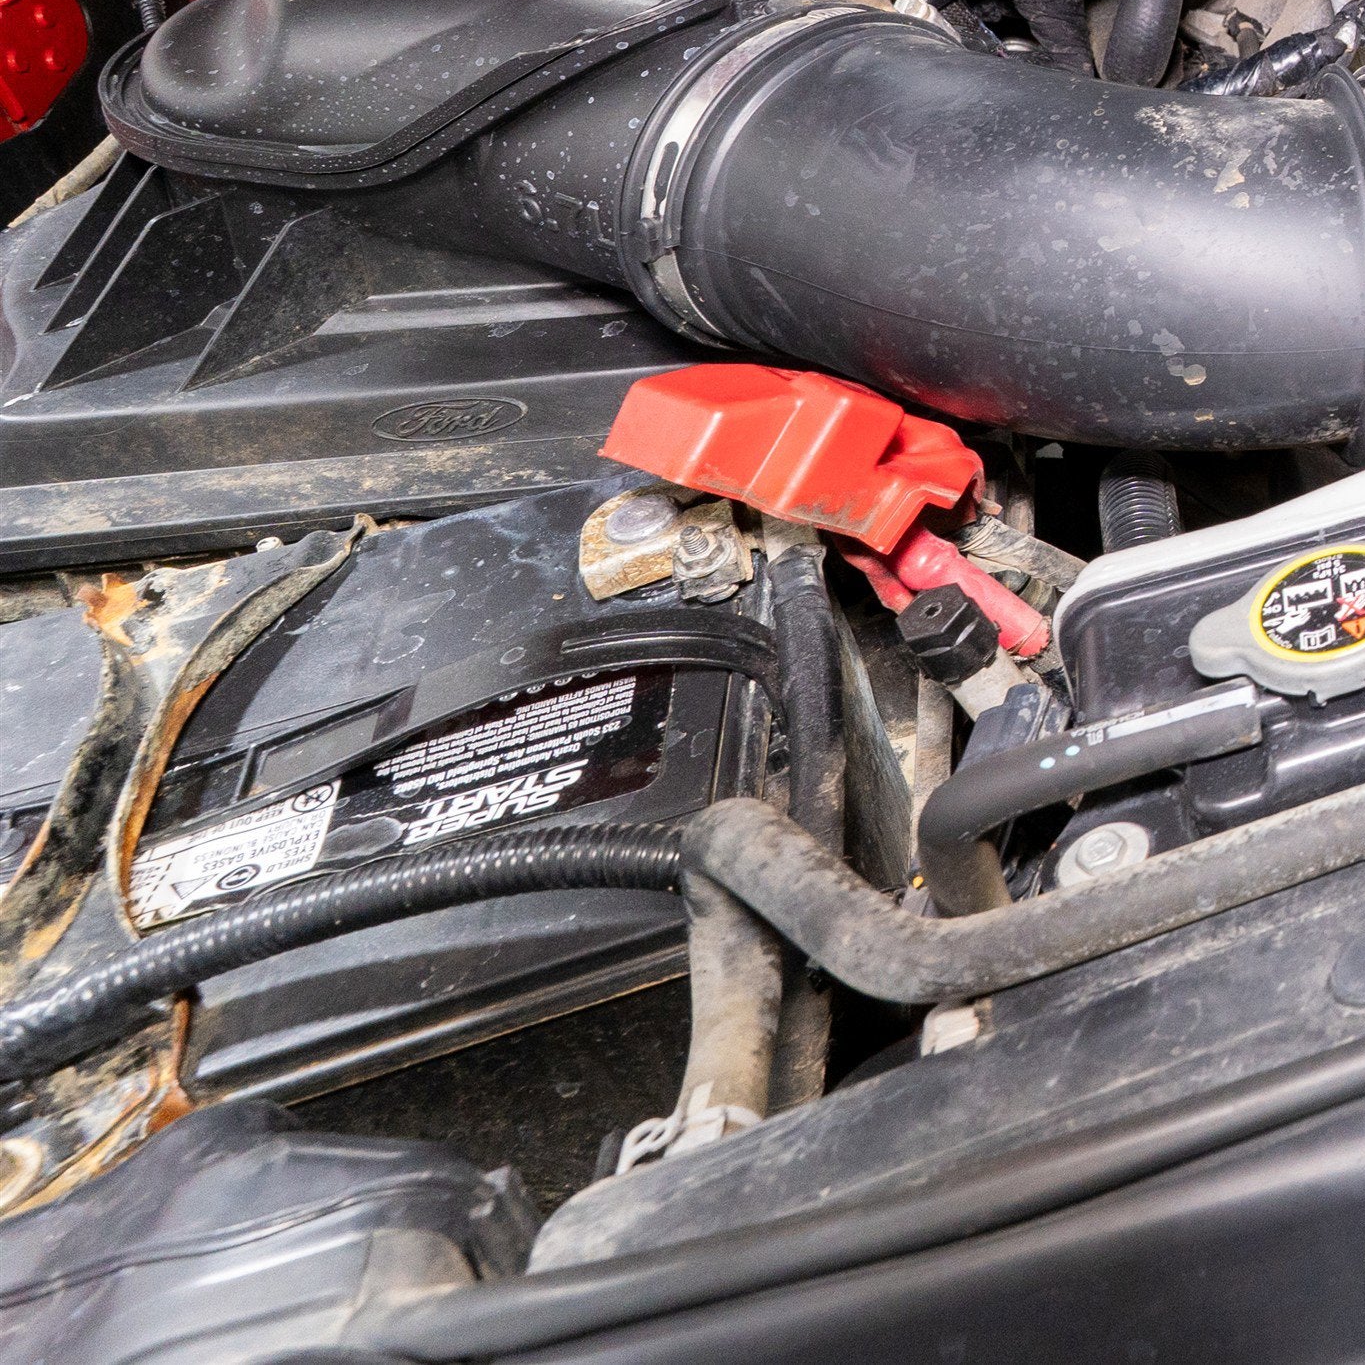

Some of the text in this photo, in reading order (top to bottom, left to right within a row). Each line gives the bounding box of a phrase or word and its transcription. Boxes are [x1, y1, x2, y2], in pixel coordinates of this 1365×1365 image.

[398, 398, 502, 437] Ford
[1262, 604, 1282, 616] OK
[558, 690, 583, 702] AFTER
[585, 683, 611, 695] HANDS
[580, 705, 631, 726] PROPOSITION
[569, 720, 578, 729] 65
[603, 721, 620, 733] 233
[575, 727, 600, 741] South
[527, 735, 571, 753] Patterson
[554, 743, 580, 757] Ozark
[499, 751, 551, 772] Automotive
[394, 778, 426, 794] 65802
[428, 772, 445, 784] MO
[407, 757, 588, 830] START
[229, 816, 252, 829] OUT
[253, 806, 284, 823] KEEP
[266, 809, 327, 835] OR INJURY
[403, 781, 564, 847] SUPER
[210, 822, 226, 835] OF
[193, 819, 325, 864] CAN CAUSE BLINDNESS
[201, 830, 320, 873] EXPLOSIVE GASES
[283, 841, 317, 860] EYES
[266, 852, 314, 874] SHIELD
